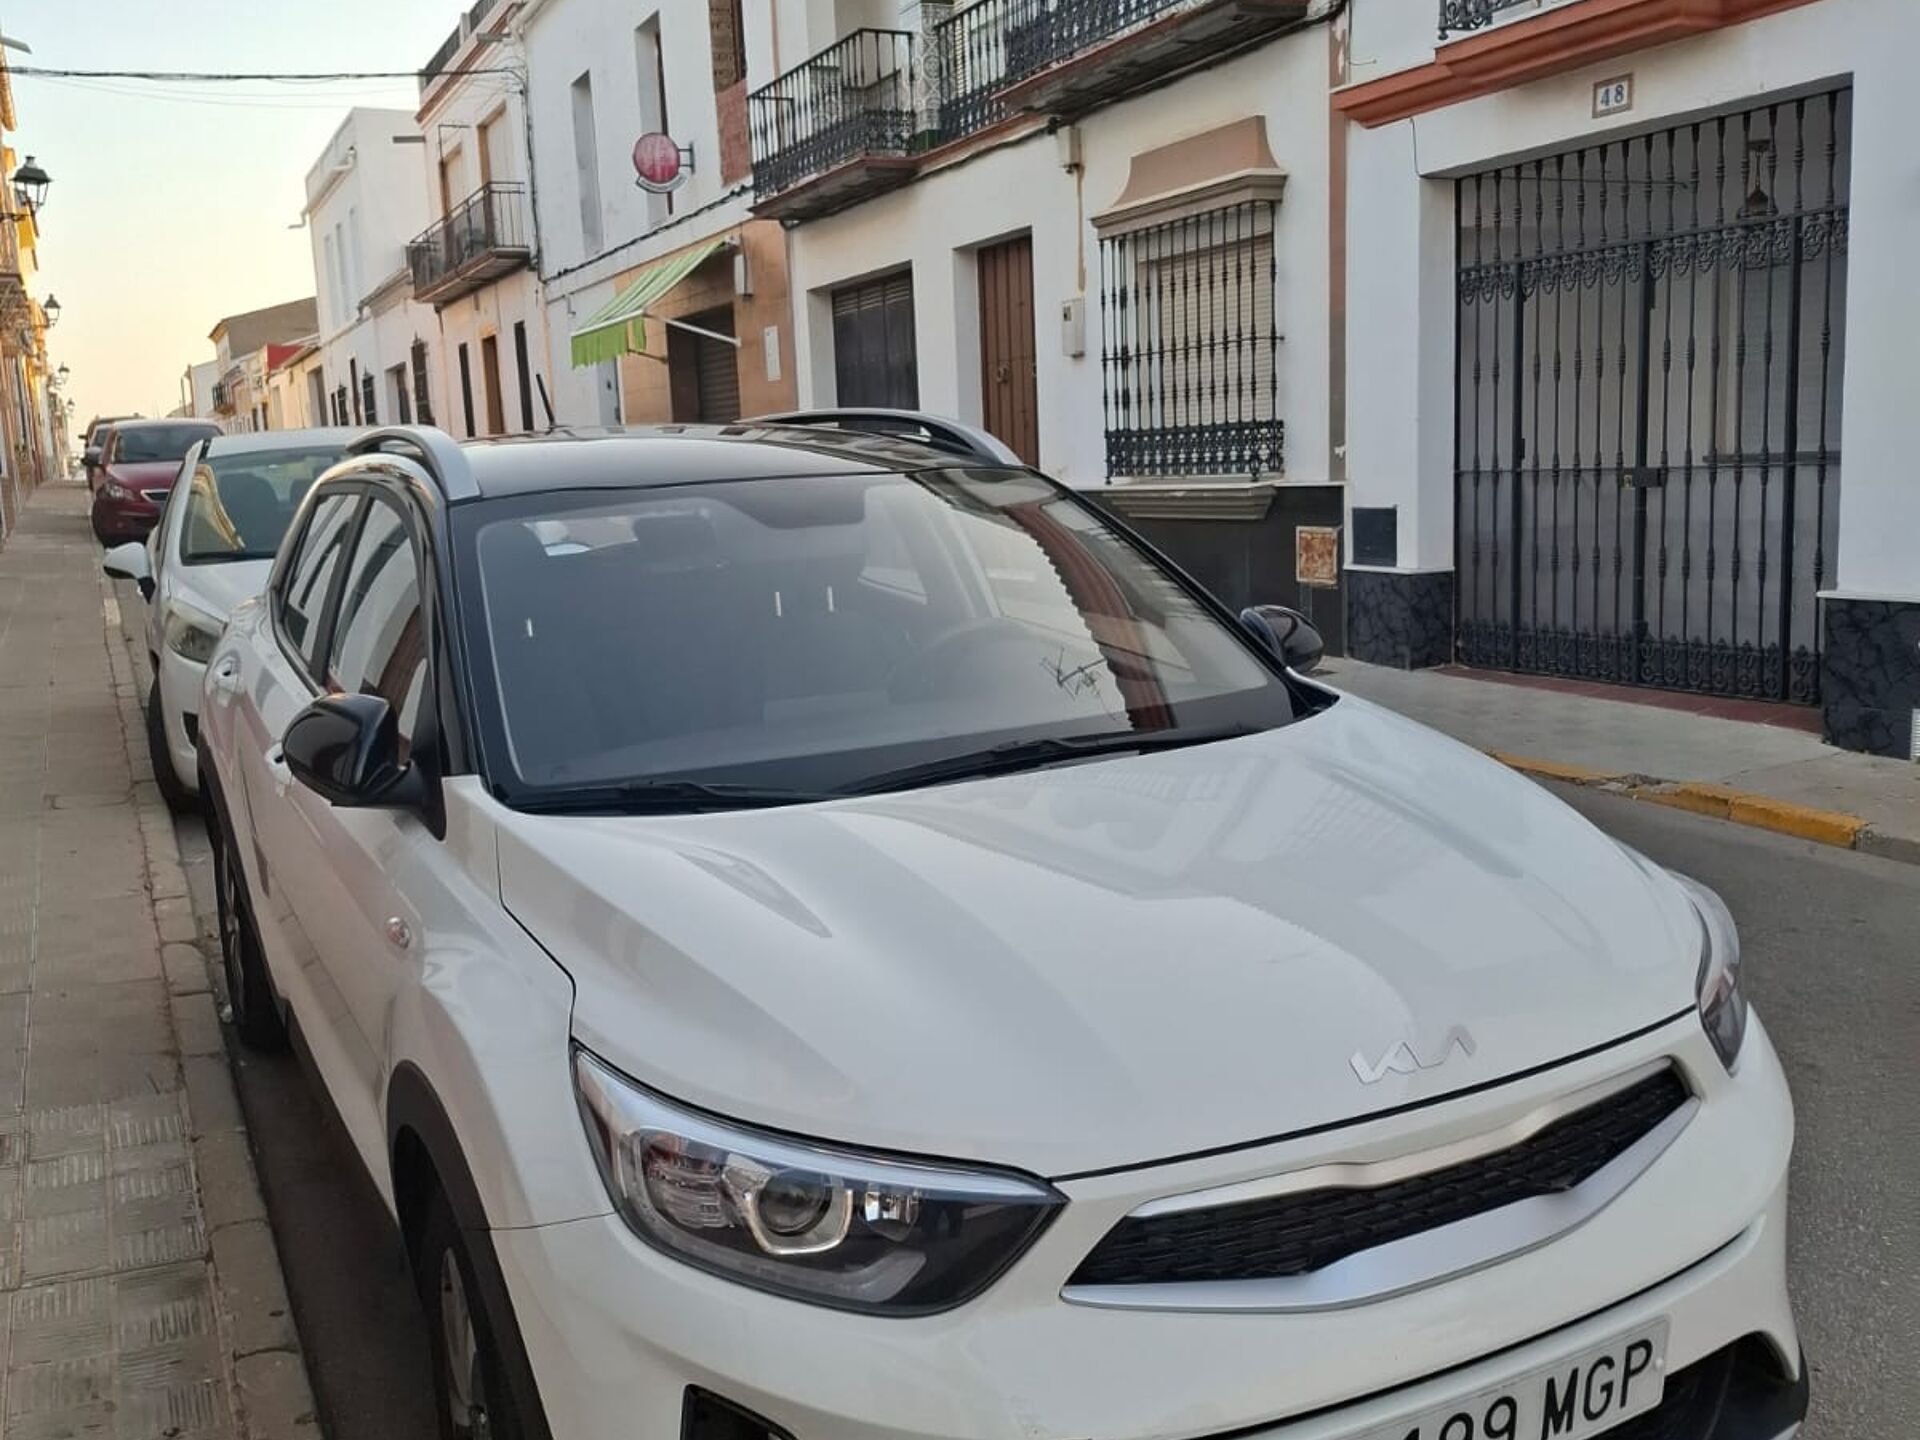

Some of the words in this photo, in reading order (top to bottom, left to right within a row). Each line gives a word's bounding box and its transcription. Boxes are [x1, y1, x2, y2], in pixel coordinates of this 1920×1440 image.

[1600, 84, 1625, 106] 48
[1349, 1024, 1477, 1085] KIA
[1403, 1395, 1517, 1440] 99
[1541, 1338, 1654, 1440] MGP
